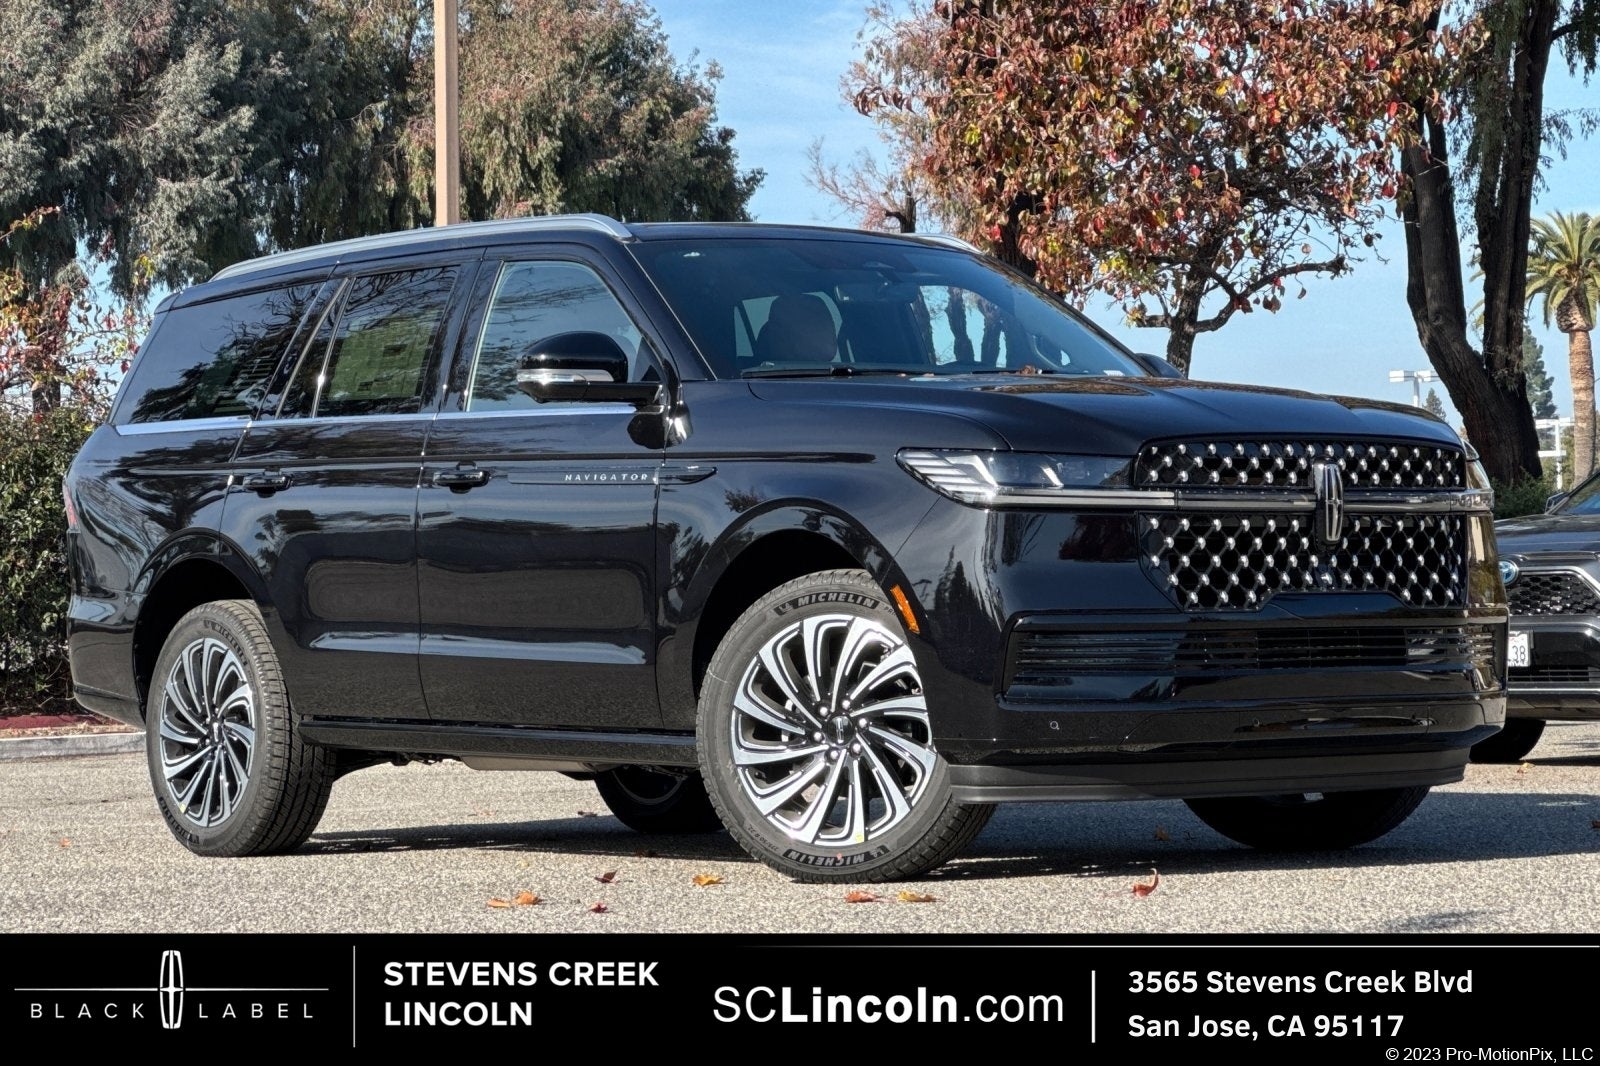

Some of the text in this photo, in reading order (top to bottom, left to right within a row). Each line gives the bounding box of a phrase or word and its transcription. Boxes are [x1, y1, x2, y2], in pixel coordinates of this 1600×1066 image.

[565, 473, 648, 481] NAVIGATOR
[798, 592, 875, 608] MICHELIN
[789, 850, 865, 867] MICHELIN
